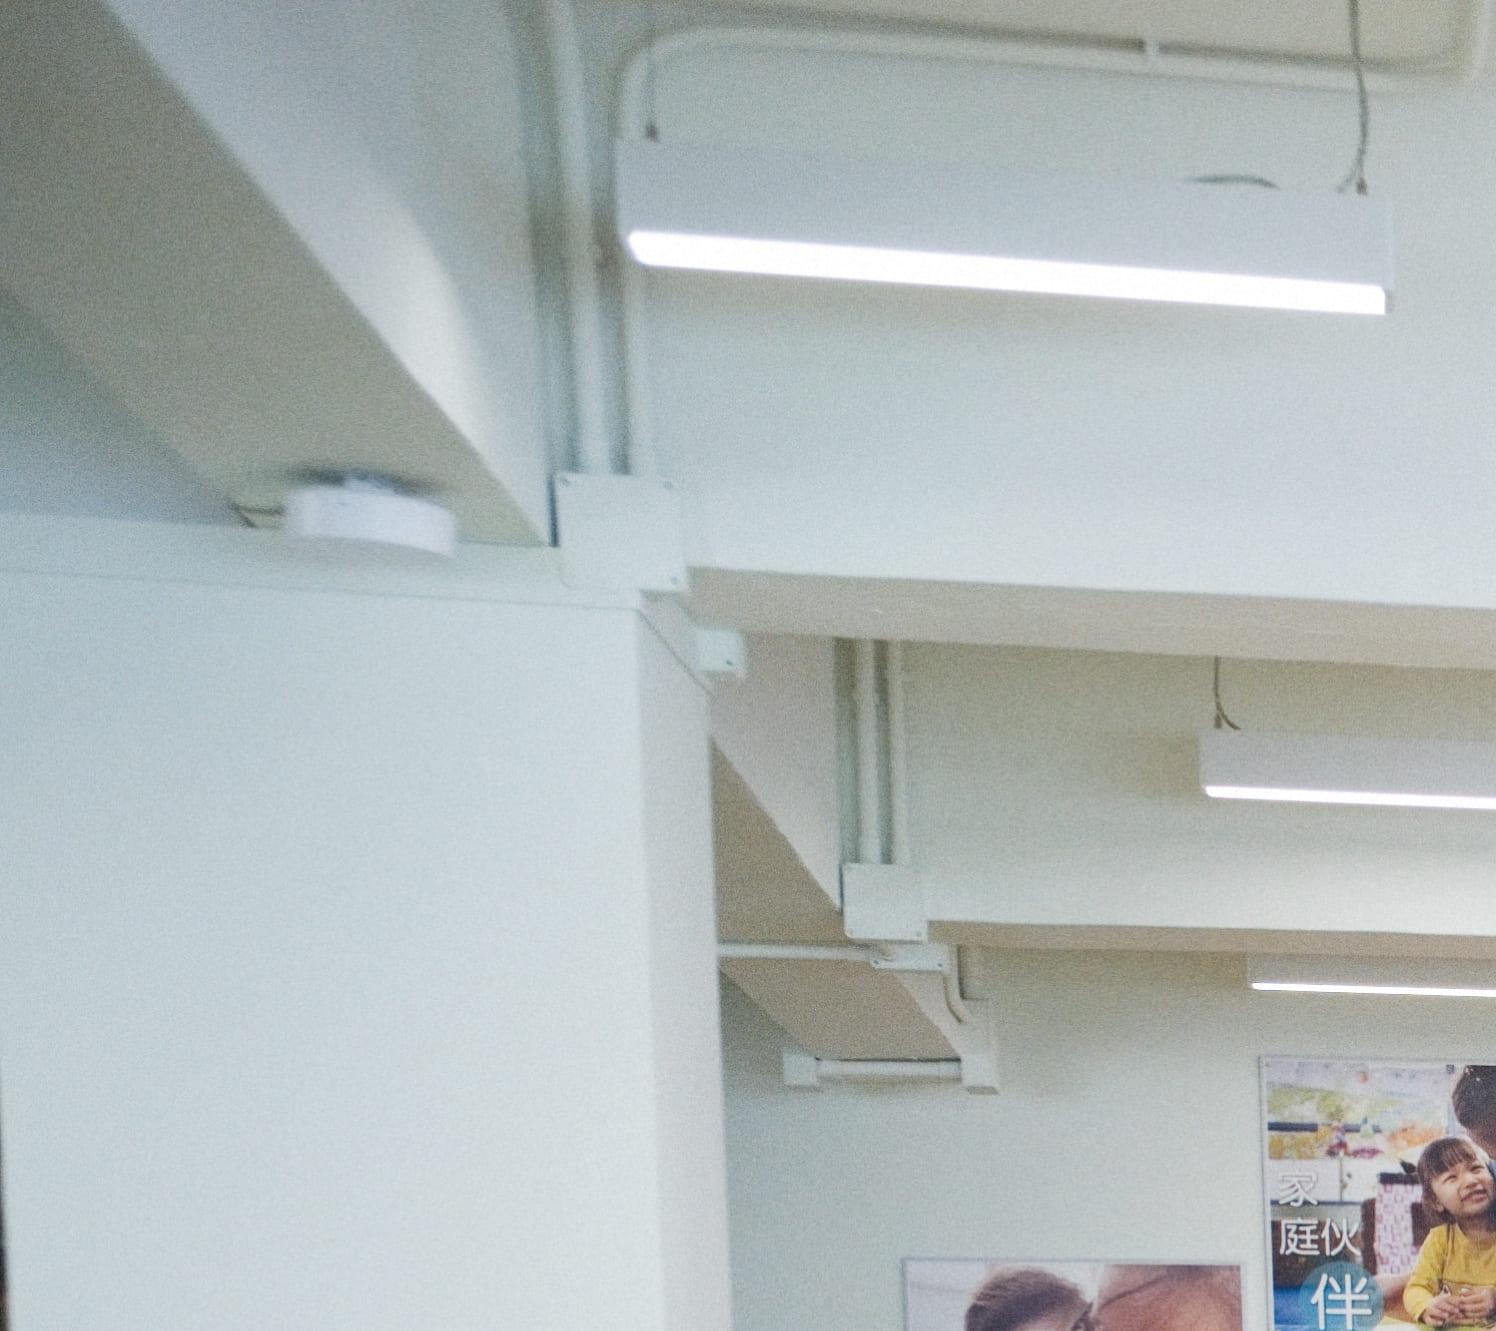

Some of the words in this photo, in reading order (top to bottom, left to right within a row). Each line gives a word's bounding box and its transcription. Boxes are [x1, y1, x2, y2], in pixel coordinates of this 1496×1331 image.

[1279, 1170, 1318, 1207] 家
[1280, 1217, 1362, 1256] 庭伙
[1310, 1273, 1372, 1331] 伴
